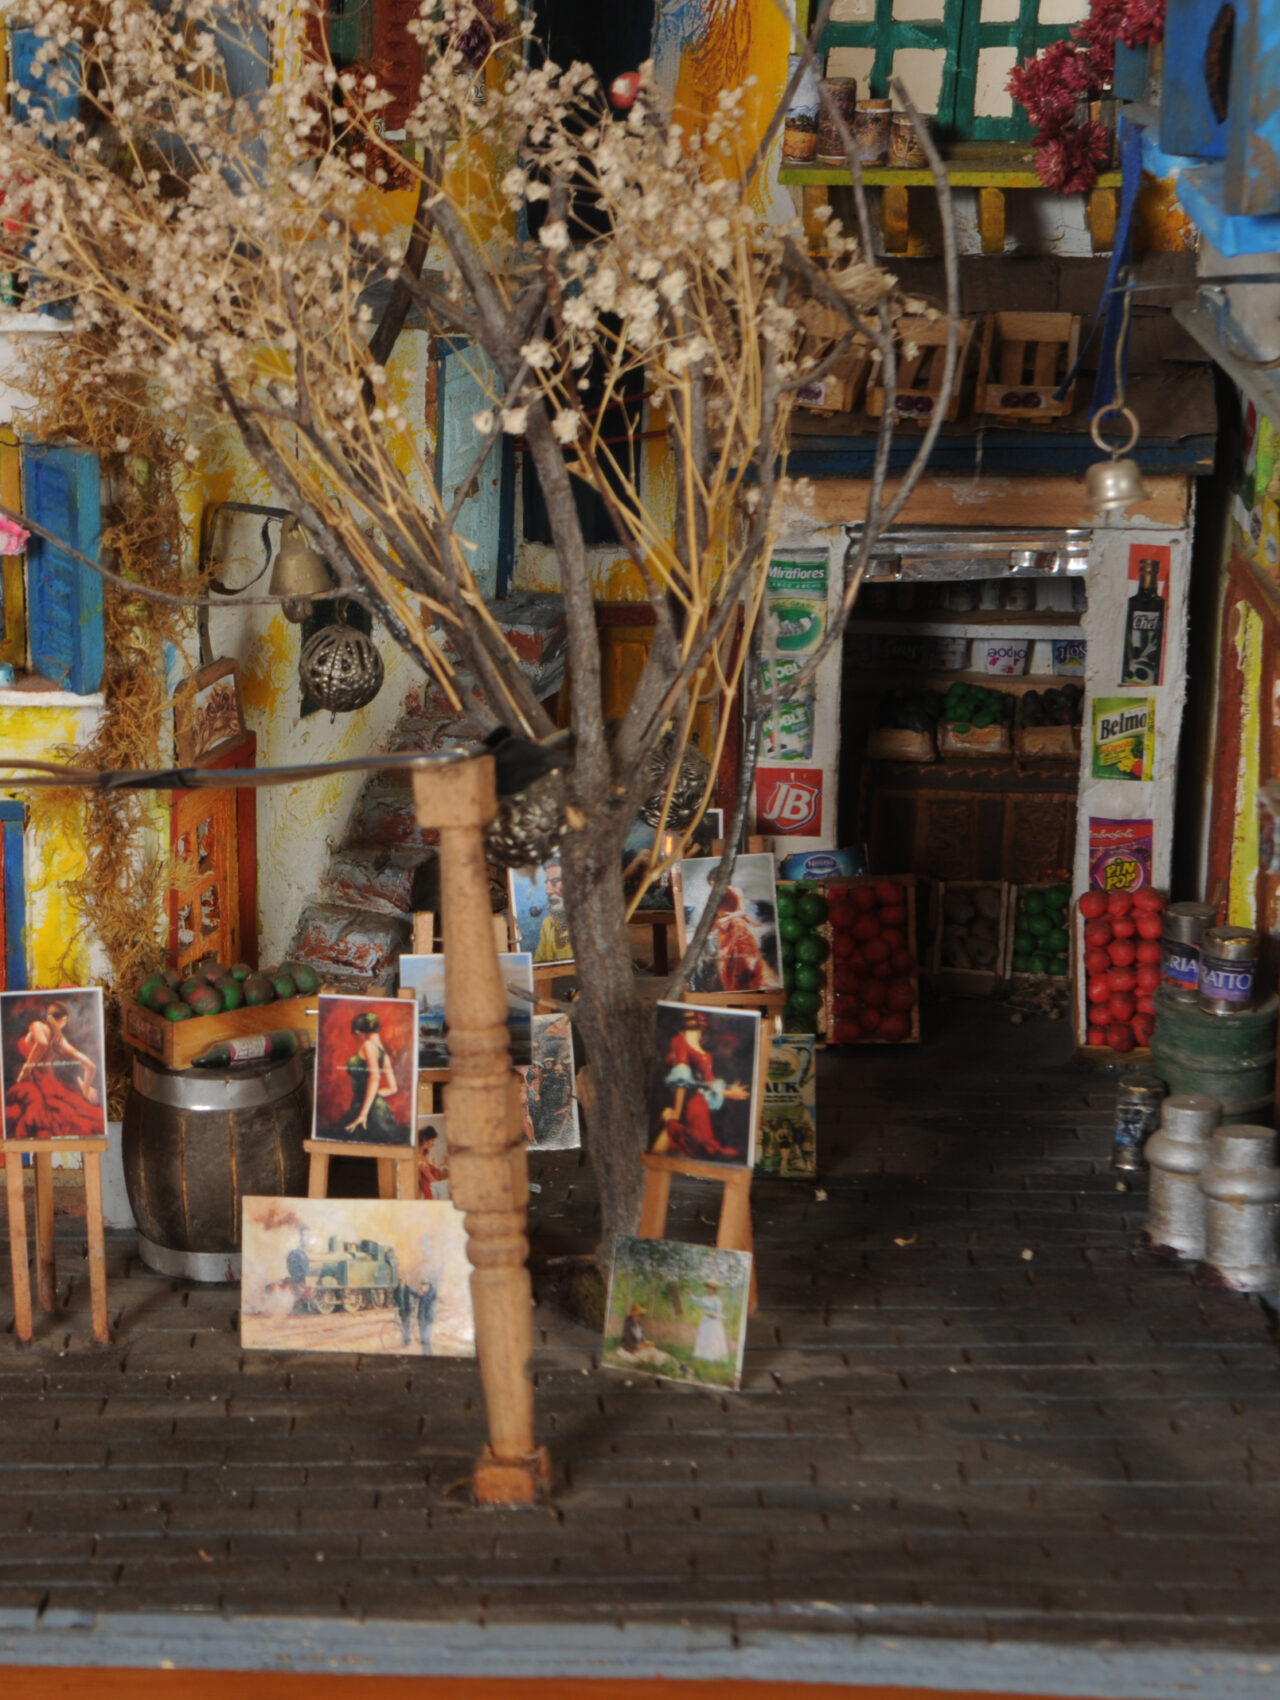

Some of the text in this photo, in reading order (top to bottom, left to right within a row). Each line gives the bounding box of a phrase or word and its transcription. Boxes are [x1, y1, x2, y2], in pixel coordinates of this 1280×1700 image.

[768, 565, 825, 580] Miraflores
[1132, 614, 1159, 631] Chef
[763, 663, 804, 682] NOBL
[762, 707, 808, 732] NBLE
[1099, 711, 1148, 740] Belmo
[762, 783, 811, 820] JB
[1104, 872, 1138, 892] POP
[1165, 954, 1197, 973] RIA
